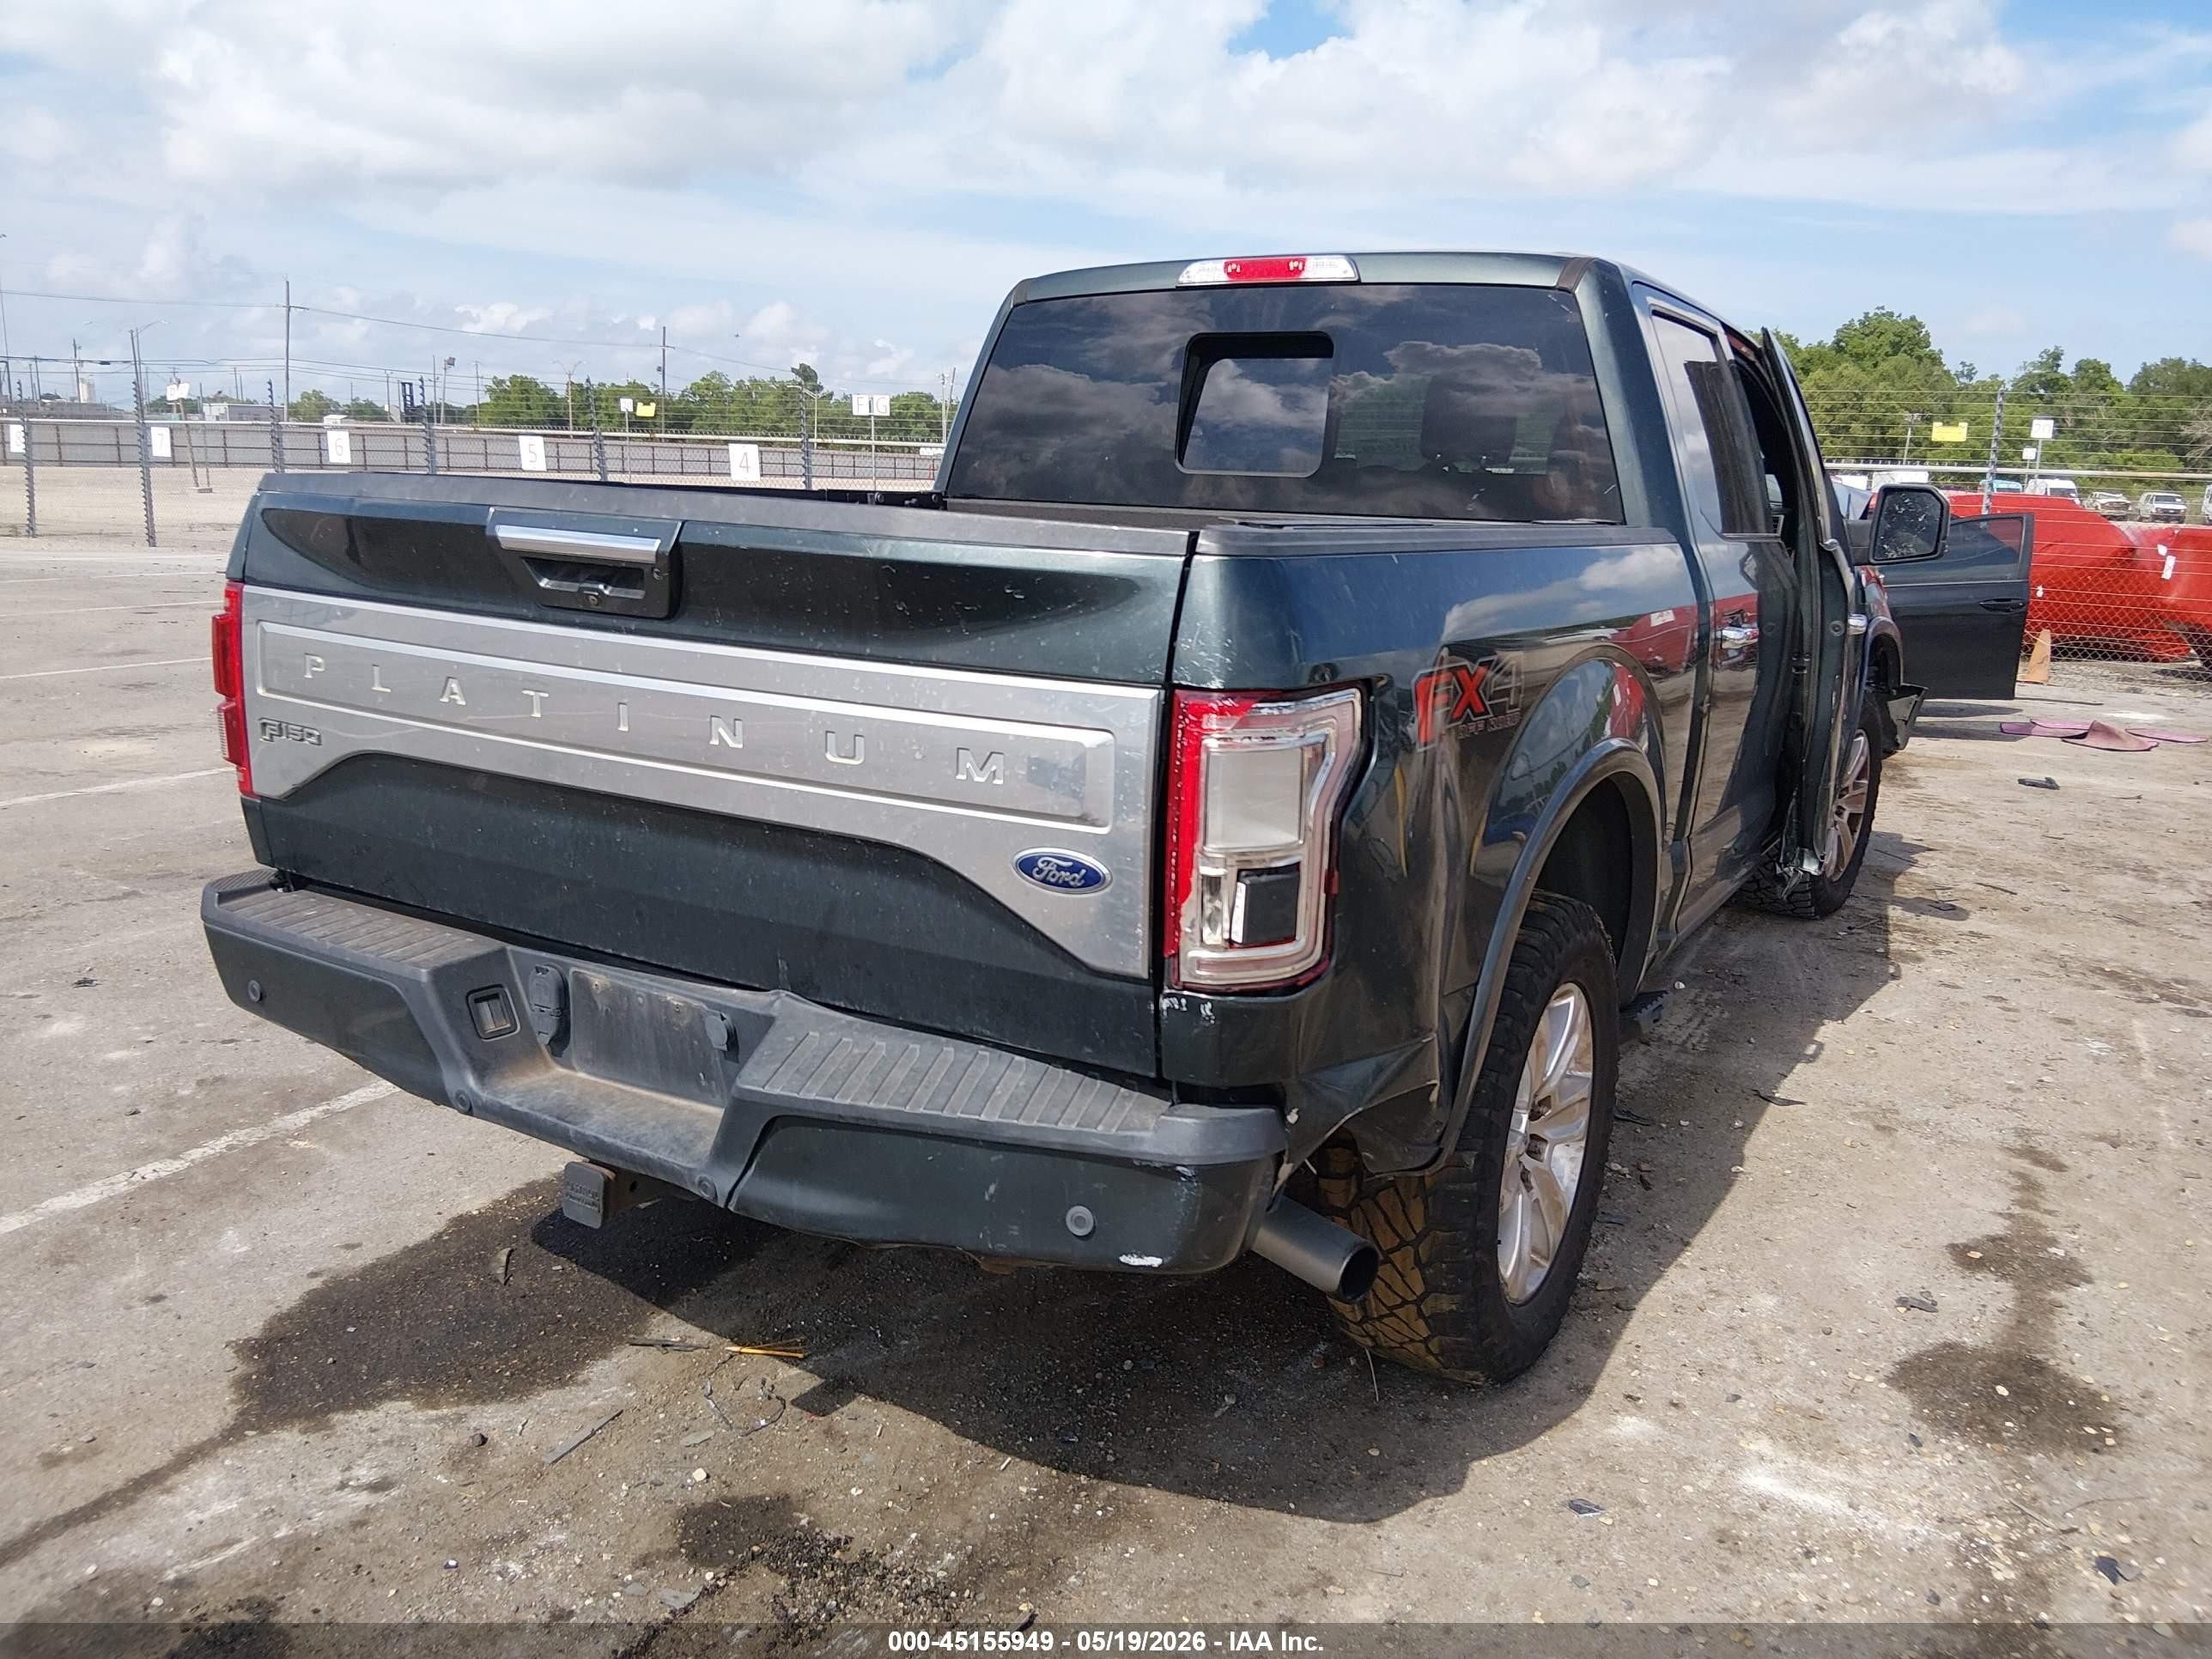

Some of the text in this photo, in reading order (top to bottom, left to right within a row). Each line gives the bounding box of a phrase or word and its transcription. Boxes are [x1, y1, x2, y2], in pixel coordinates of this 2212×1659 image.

[856, 397, 865, 413] F
[876, 397, 888, 414] G
[2033, 422, 2051, 434] 20
[157, 433, 165, 451] 7
[335, 438, 343, 456] 6
[528, 443, 538, 463] 5
[738, 452, 751, 473] 4
[1411, 650, 1525, 752] FX4
[303, 653, 1004, 785] PLATINUM
[1032, 856, 1086, 888] Ford
